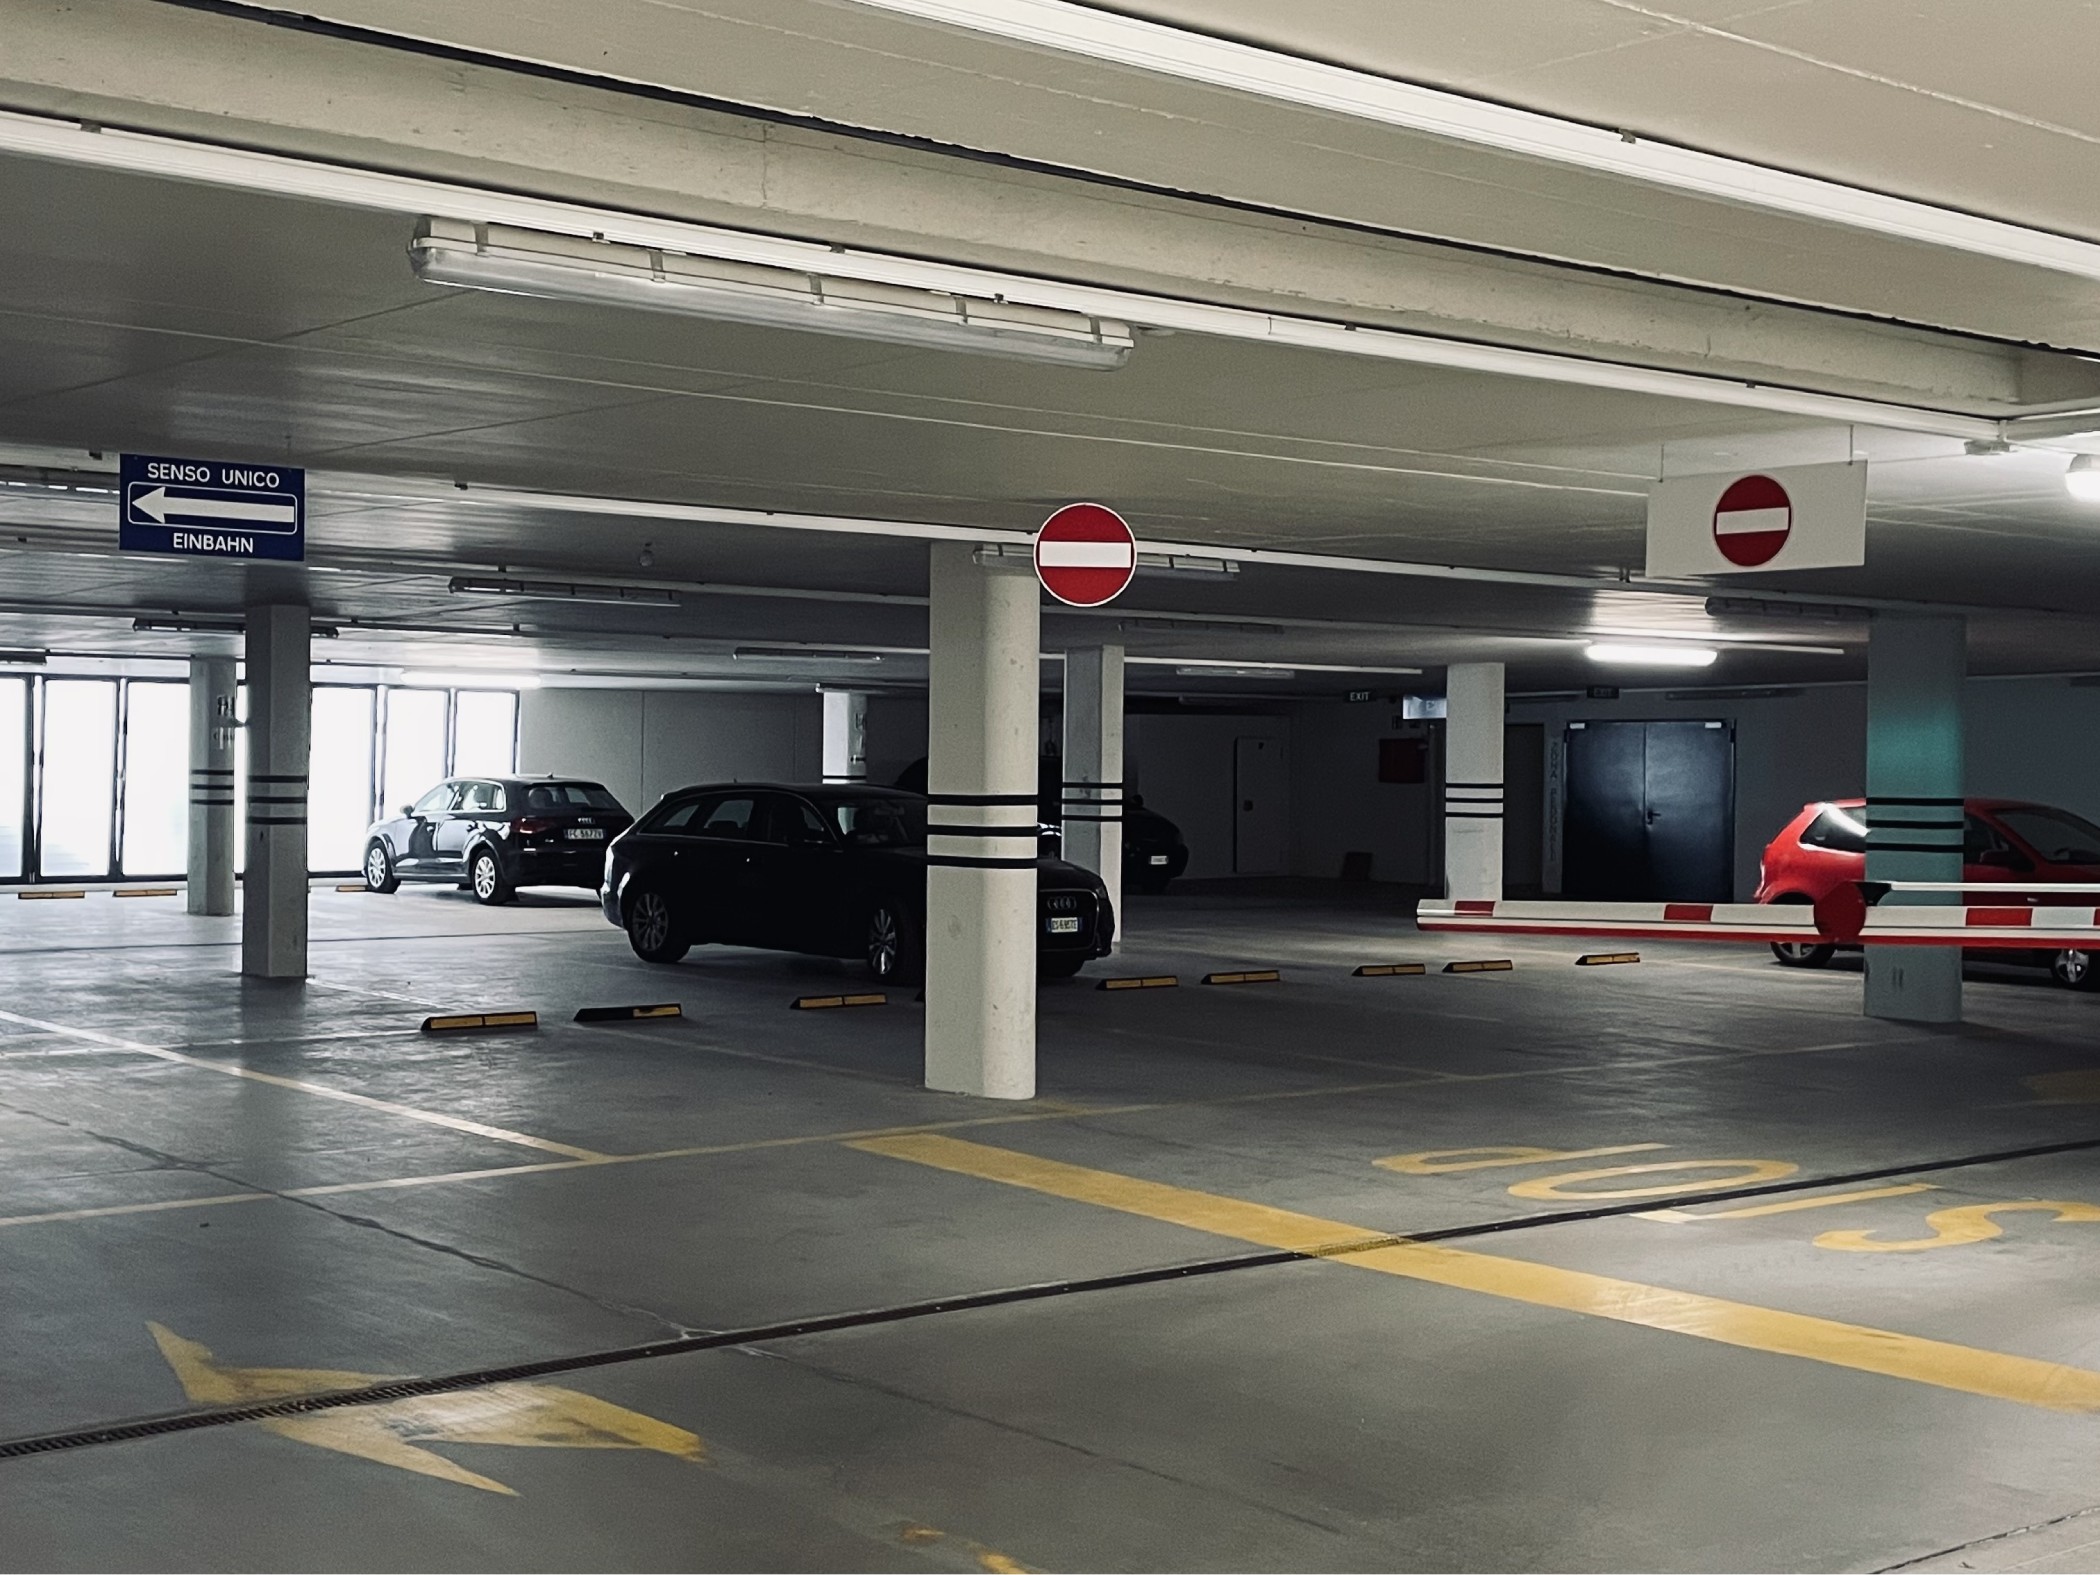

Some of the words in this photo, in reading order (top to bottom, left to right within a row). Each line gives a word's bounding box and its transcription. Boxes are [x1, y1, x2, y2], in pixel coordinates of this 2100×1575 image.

[147, 462, 211, 483] SENSO
[221, 468, 280, 489] UNICO
[173, 532, 254, 554] EINBAHN
[1349, 691, 1370, 701] EXIT
[1371, 1142, 2100, 1253] STOP
